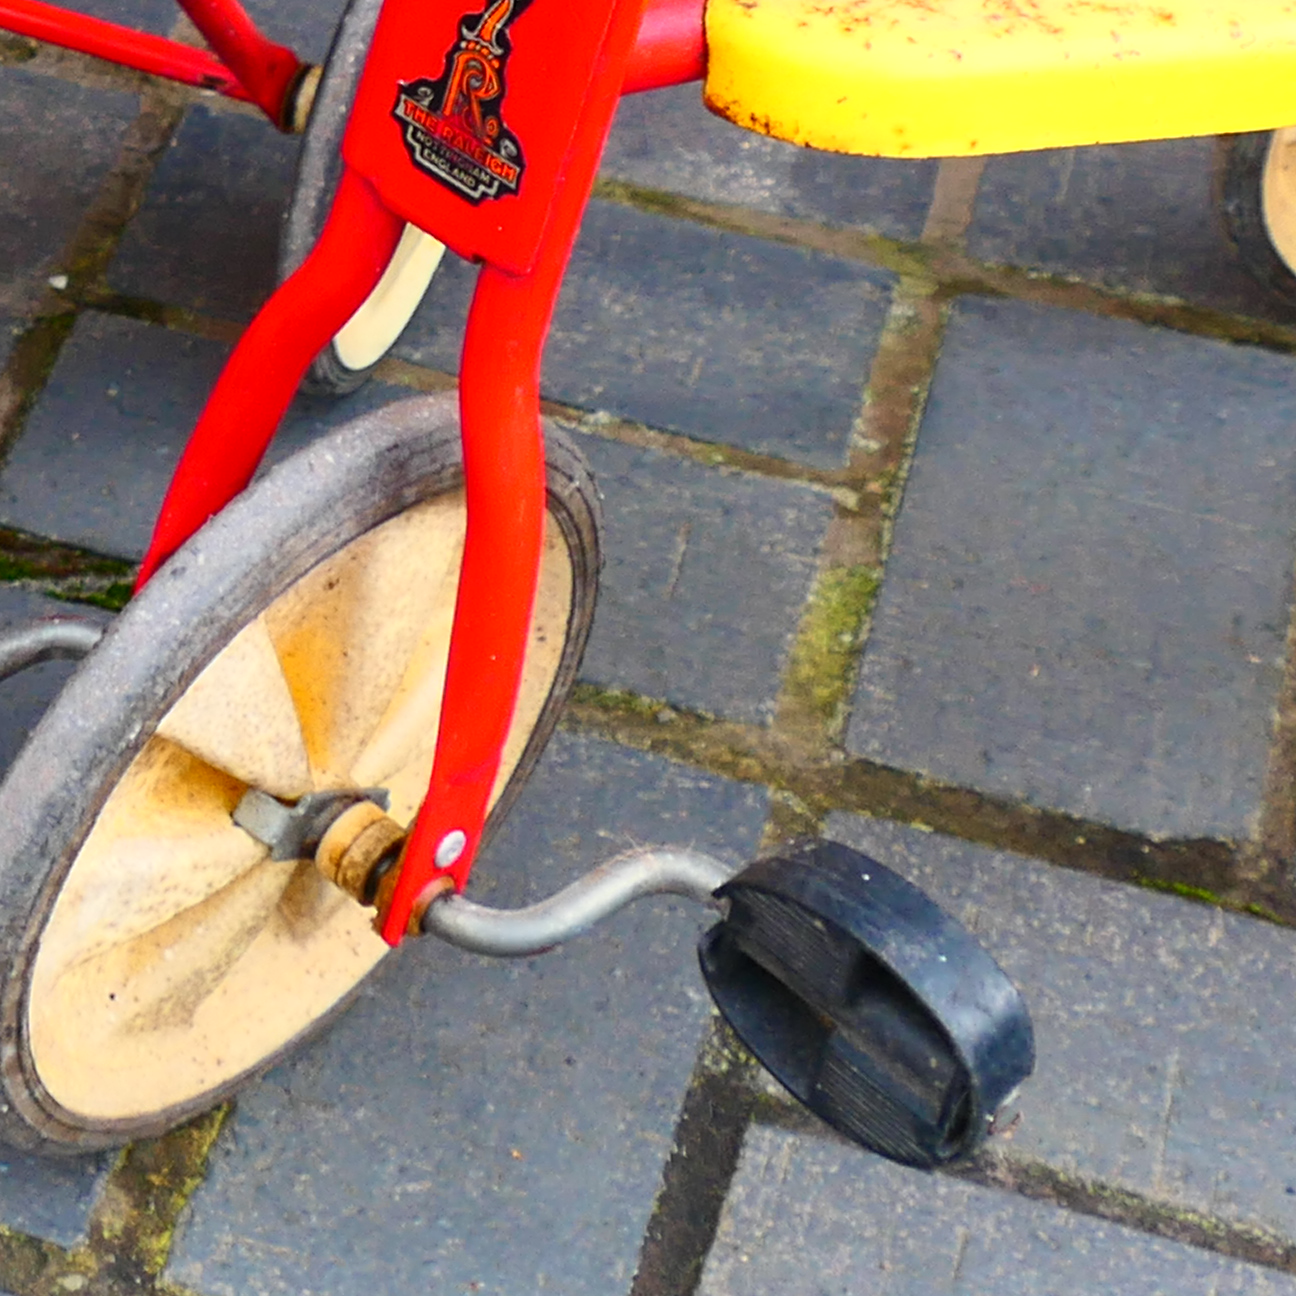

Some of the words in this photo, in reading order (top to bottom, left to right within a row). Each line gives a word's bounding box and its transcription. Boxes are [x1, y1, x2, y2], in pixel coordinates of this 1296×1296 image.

[403, 100, 438, 132] THE
[442, 125, 518, 183] RALEIGH
[416, 130, 491, 184] NOTTINGHAM
[423, 149, 476, 187] ENGLAND
